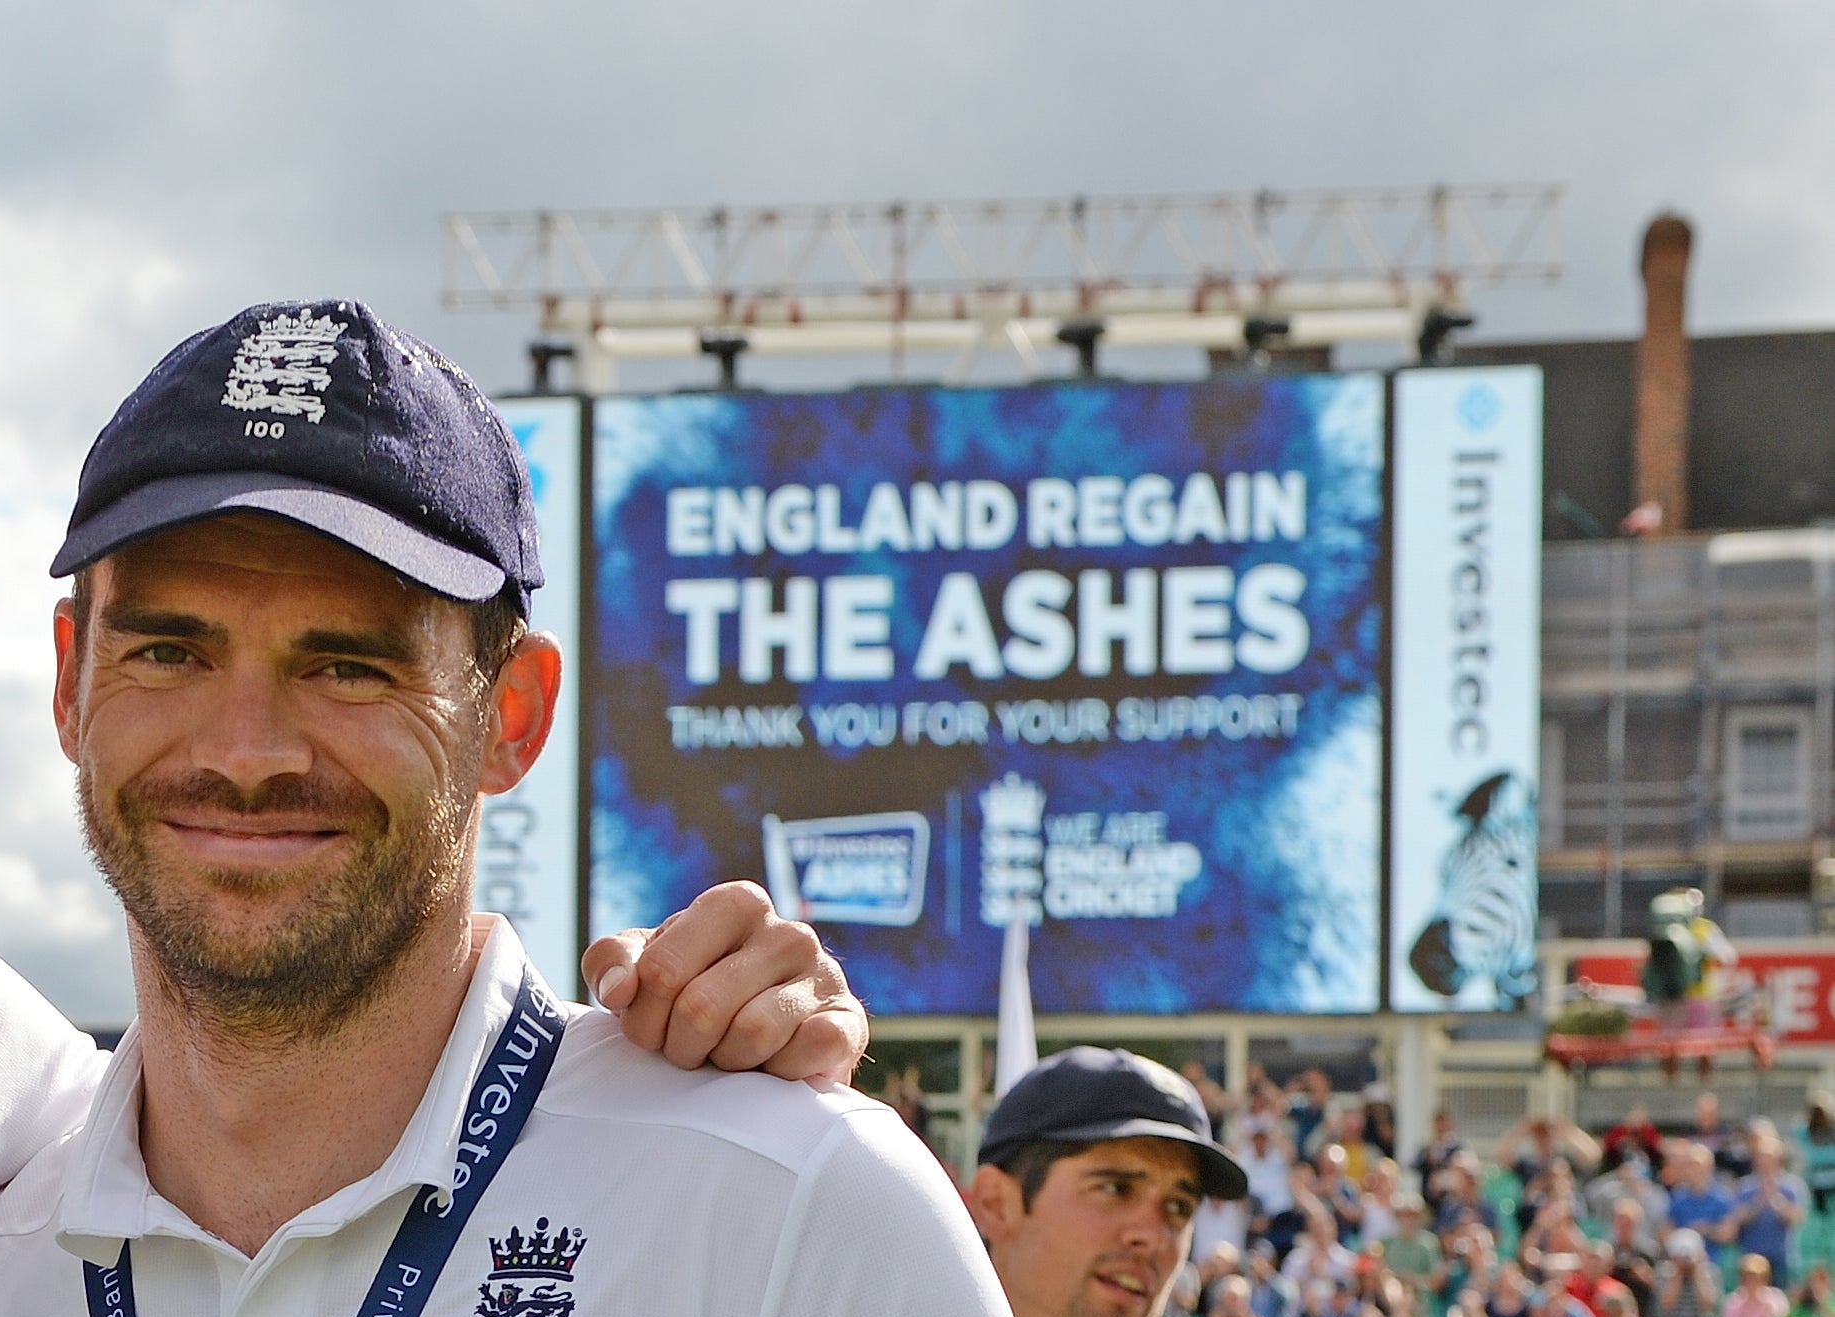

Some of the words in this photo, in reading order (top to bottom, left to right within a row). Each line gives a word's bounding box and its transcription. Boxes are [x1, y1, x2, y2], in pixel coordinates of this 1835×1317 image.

[245, 420, 285, 439] 100
[667, 480, 1018, 556] ENGLAND
[1026, 471, 1307, 548] REGAIN
[665, 576, 895, 684] THE
[912, 563, 1310, 681] ASHES
[668, 705, 803, 750] THANK
[809, 702, 897, 747] YOU
[903, 701, 989, 746] FOR
[995, 698, 1109, 743] YOUR
[1115, 693, 1303, 741] SUPPORT
